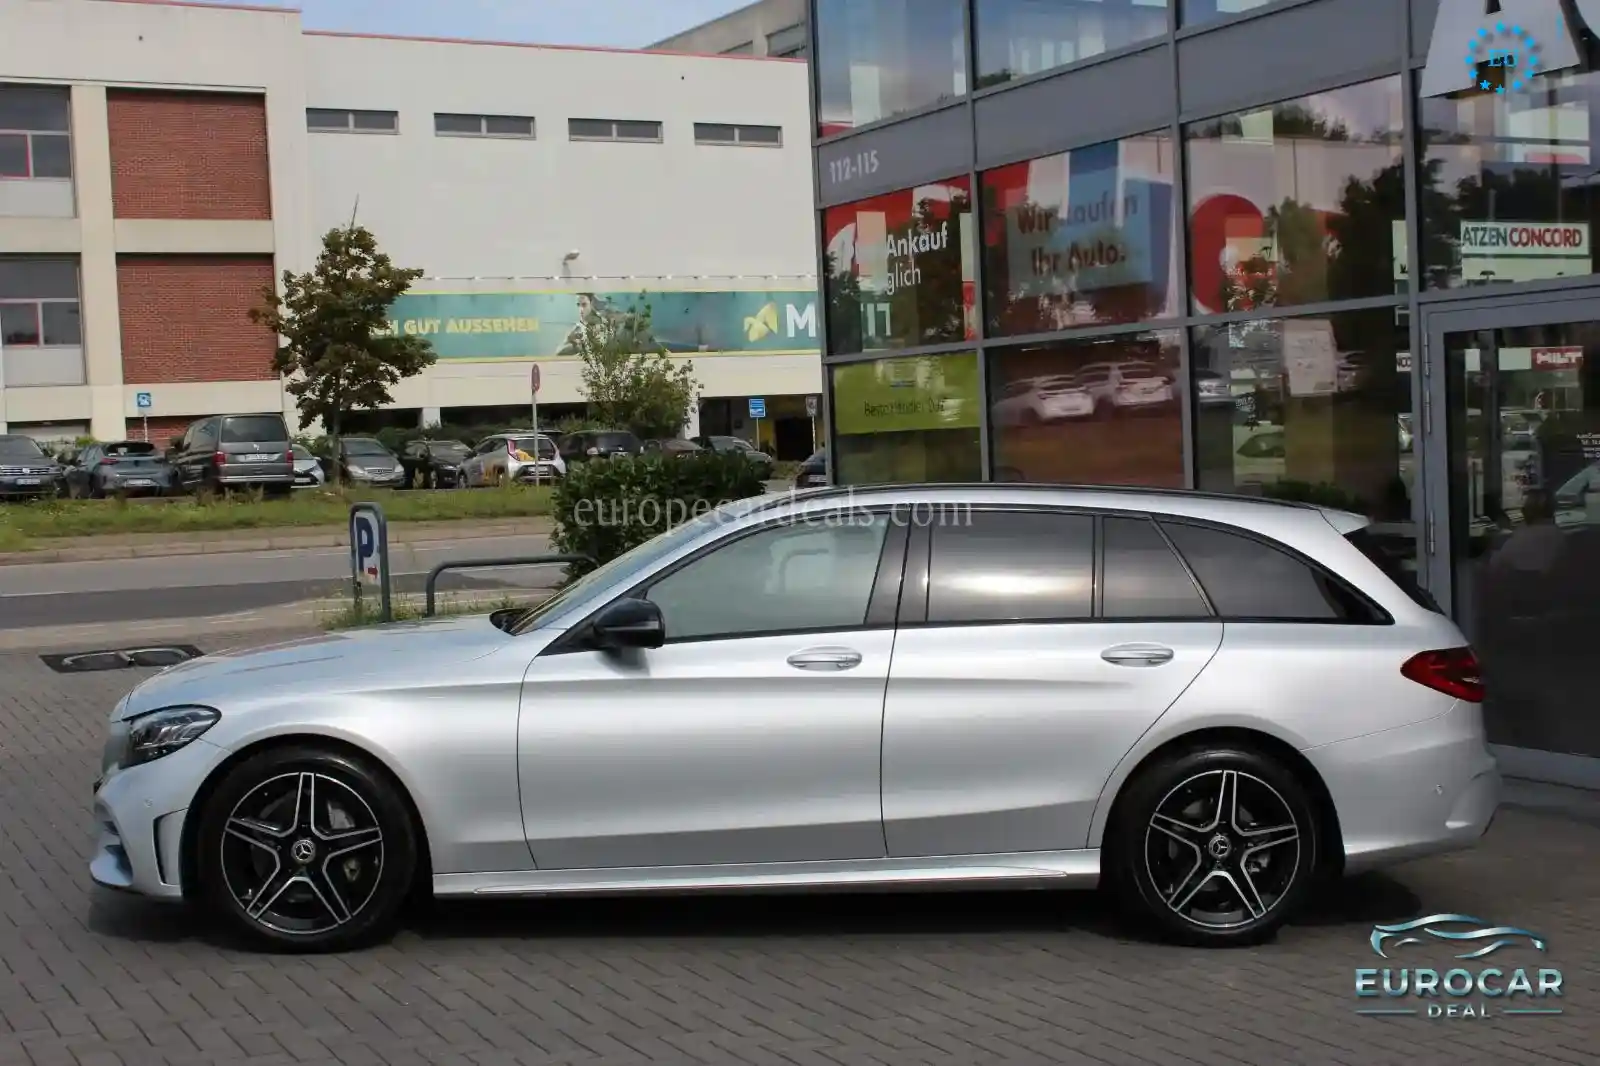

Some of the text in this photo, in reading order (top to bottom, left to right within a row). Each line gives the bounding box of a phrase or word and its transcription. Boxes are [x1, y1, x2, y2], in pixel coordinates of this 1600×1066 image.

[829, 151, 879, 183] 112-115
[1017, 191, 1138, 234] Wir aufn
[886, 220, 948, 257] Ankauf
[1509, 227, 1582, 248] CONCORD
[404, 318, 441, 335] GUT
[445, 317, 539, 334] AUSSEHEN
[355, 517, 375, 573] P
